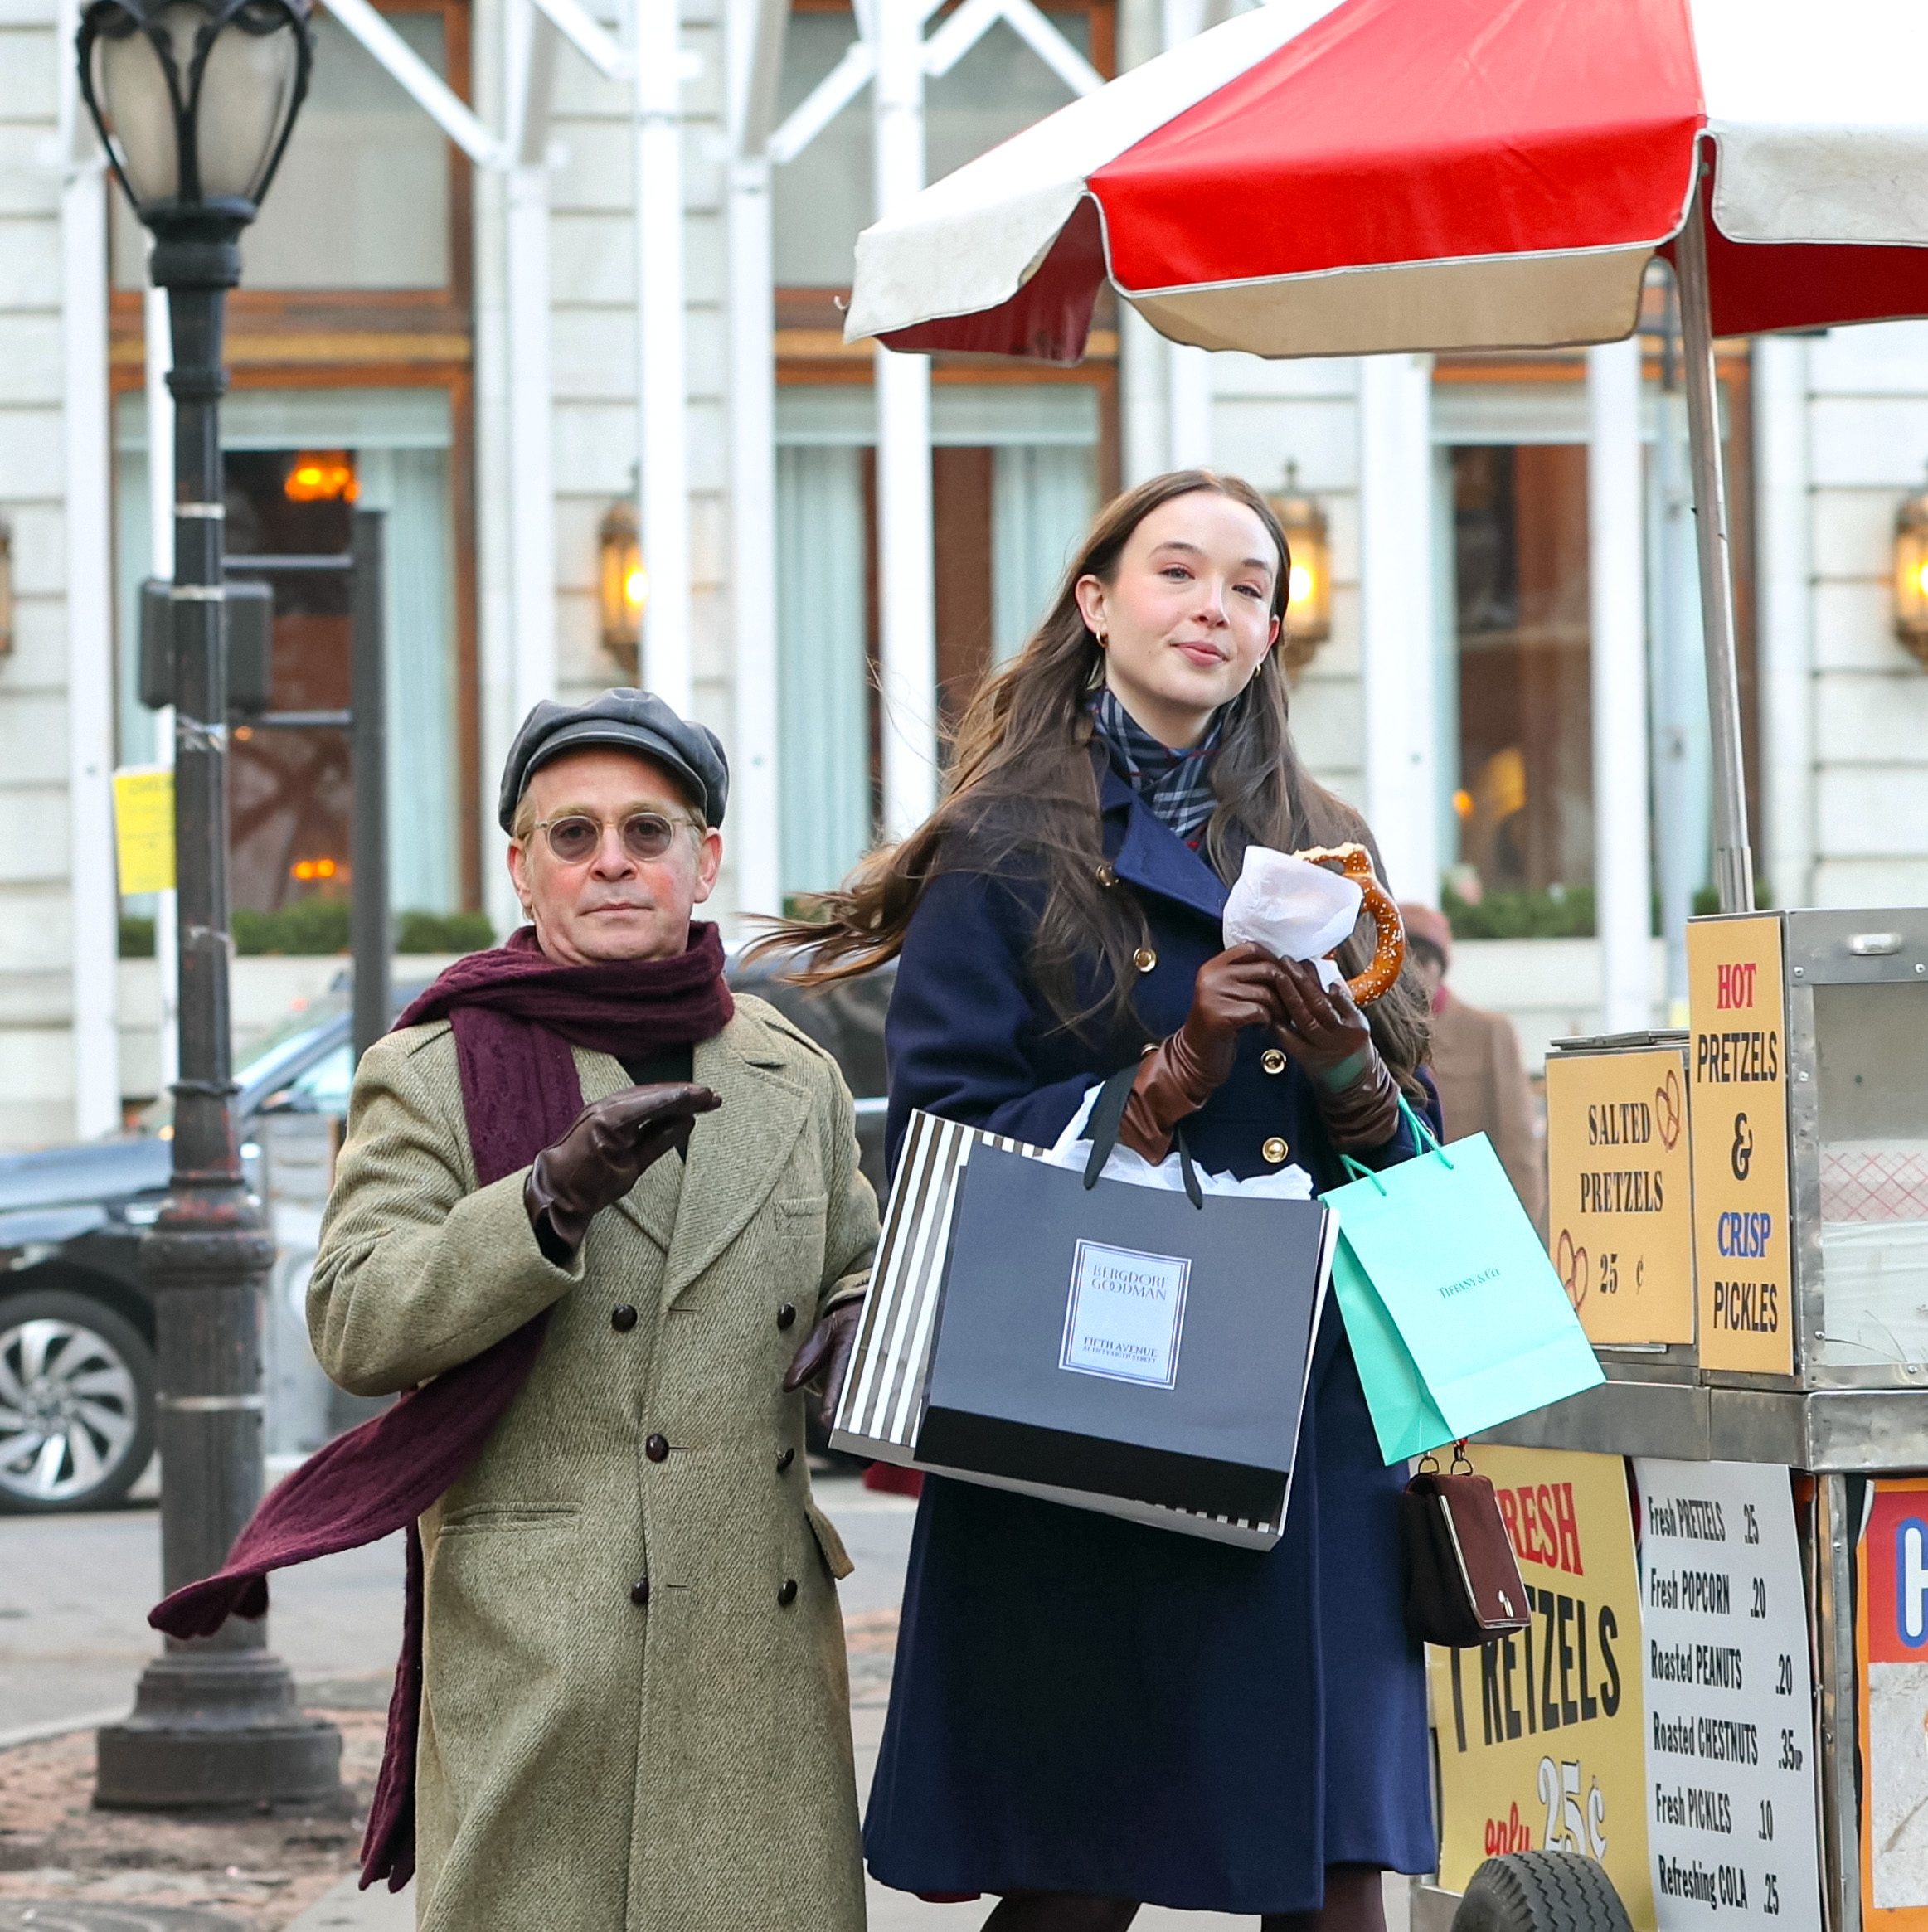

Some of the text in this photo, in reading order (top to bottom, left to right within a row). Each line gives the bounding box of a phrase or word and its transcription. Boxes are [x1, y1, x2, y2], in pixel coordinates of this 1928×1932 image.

[1717, 963, 1756, 1009] HOT
[1697, 1031, 1778, 1083] PRETZELS
[1588, 1102, 1650, 1146] SALTED
[1731, 1112, 1753, 1181] &
[1580, 1170, 1663, 1213] PRETZELS
[1717, 1211, 1771, 1258] CRISP
[1091, 1278, 1167, 1301] GOODMAN
[1093, 1265, 1168, 1289] BERGDORF
[1437, 1277, 1476, 1299] TIFFANY
[1599, 1253, 1618, 1294] 25
[1713, 1281, 1778, 1332] PICKLES
[1115, 1342, 1158, 1357] AVENUE
[1495, 1482, 1584, 1576] RESH
[1648, 1496, 1760, 1545] Fresh PRETZELS .25
[1650, 1567, 1766, 1619] Fresh POPCORN .20
[1651, 1639, 1793, 1696] Roasted PEANUTS .20
[1653, 1711, 1695, 1756] Roasted
[1698, 1716, 1759, 1765] CHESTNUTS
[1655, 1783, 1774, 1842] Fresh PICKLES .10
[1658, 1854, 1779, 1915] Refreshing COLA .25
